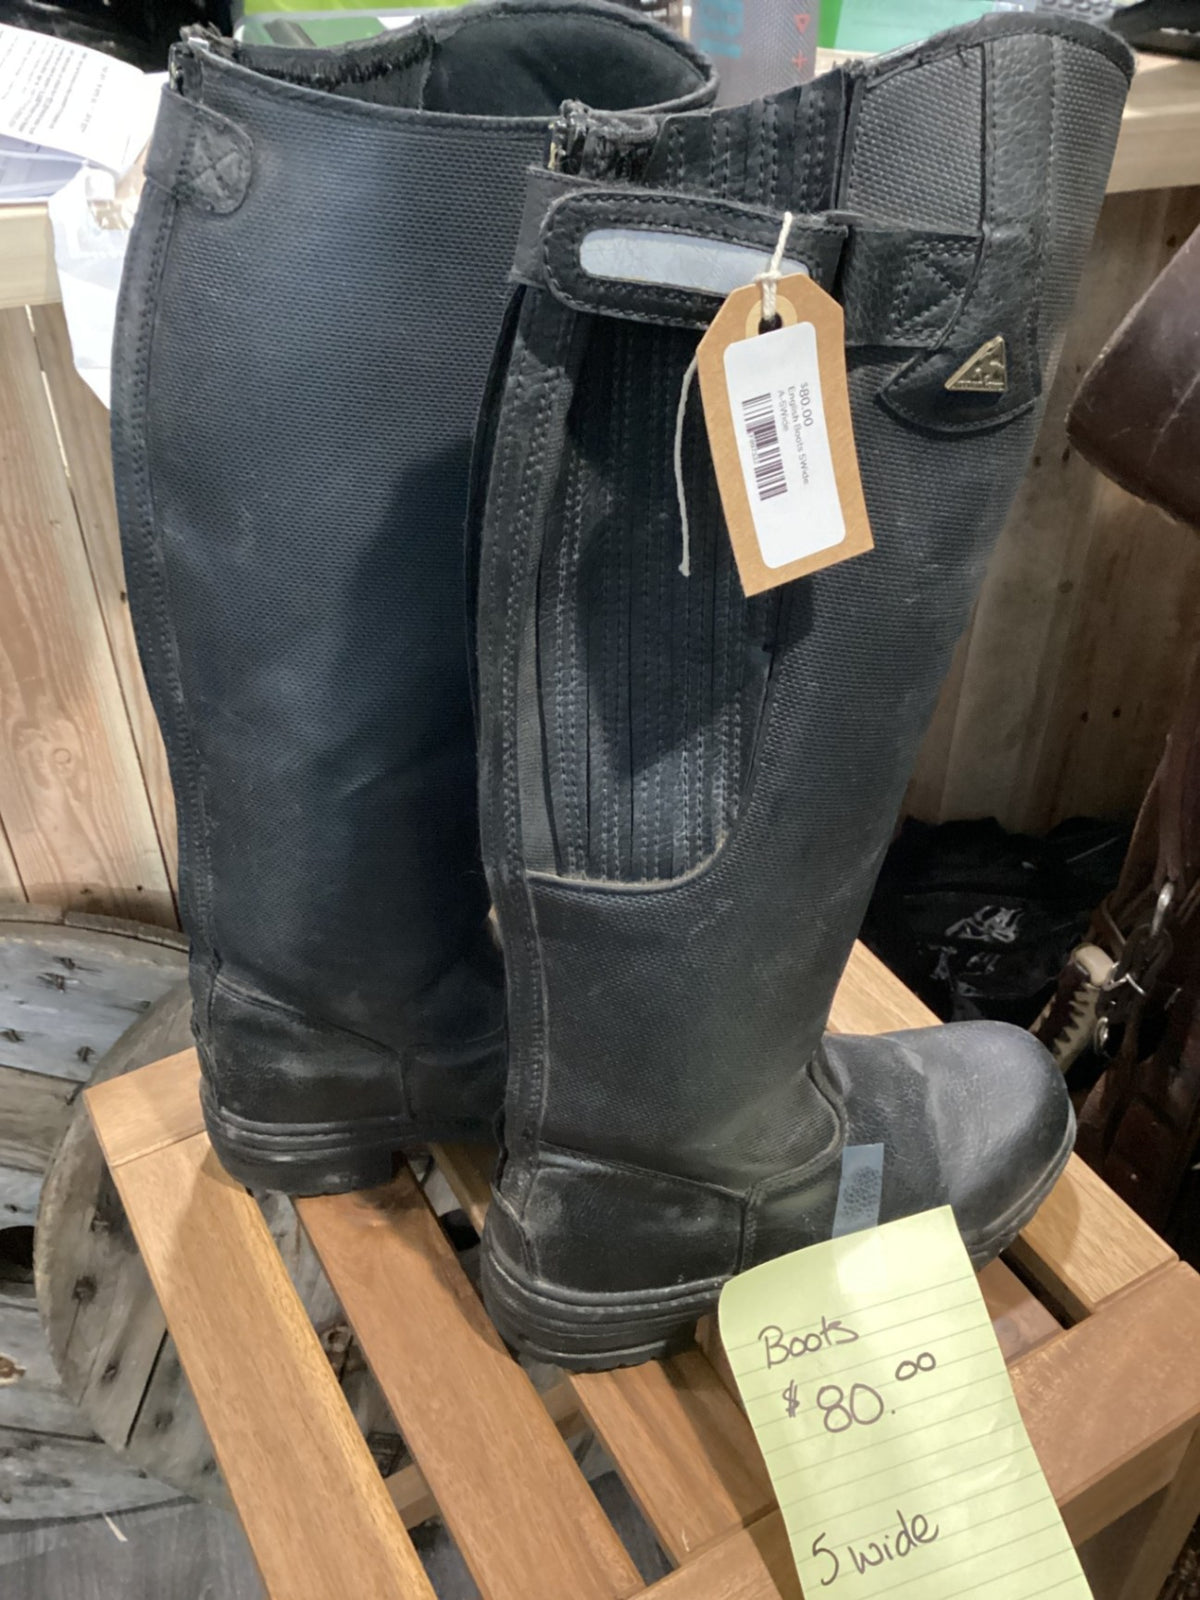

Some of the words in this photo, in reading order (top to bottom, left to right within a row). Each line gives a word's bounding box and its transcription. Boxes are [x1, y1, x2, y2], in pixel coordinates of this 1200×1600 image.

[788, 386, 799, 422] English
[800, 382, 814, 427] $80.00
[793, 423, 803, 452] Boots
[758, 1316, 859, 1369] Boots
[847, 1510, 940, 1574] wide
